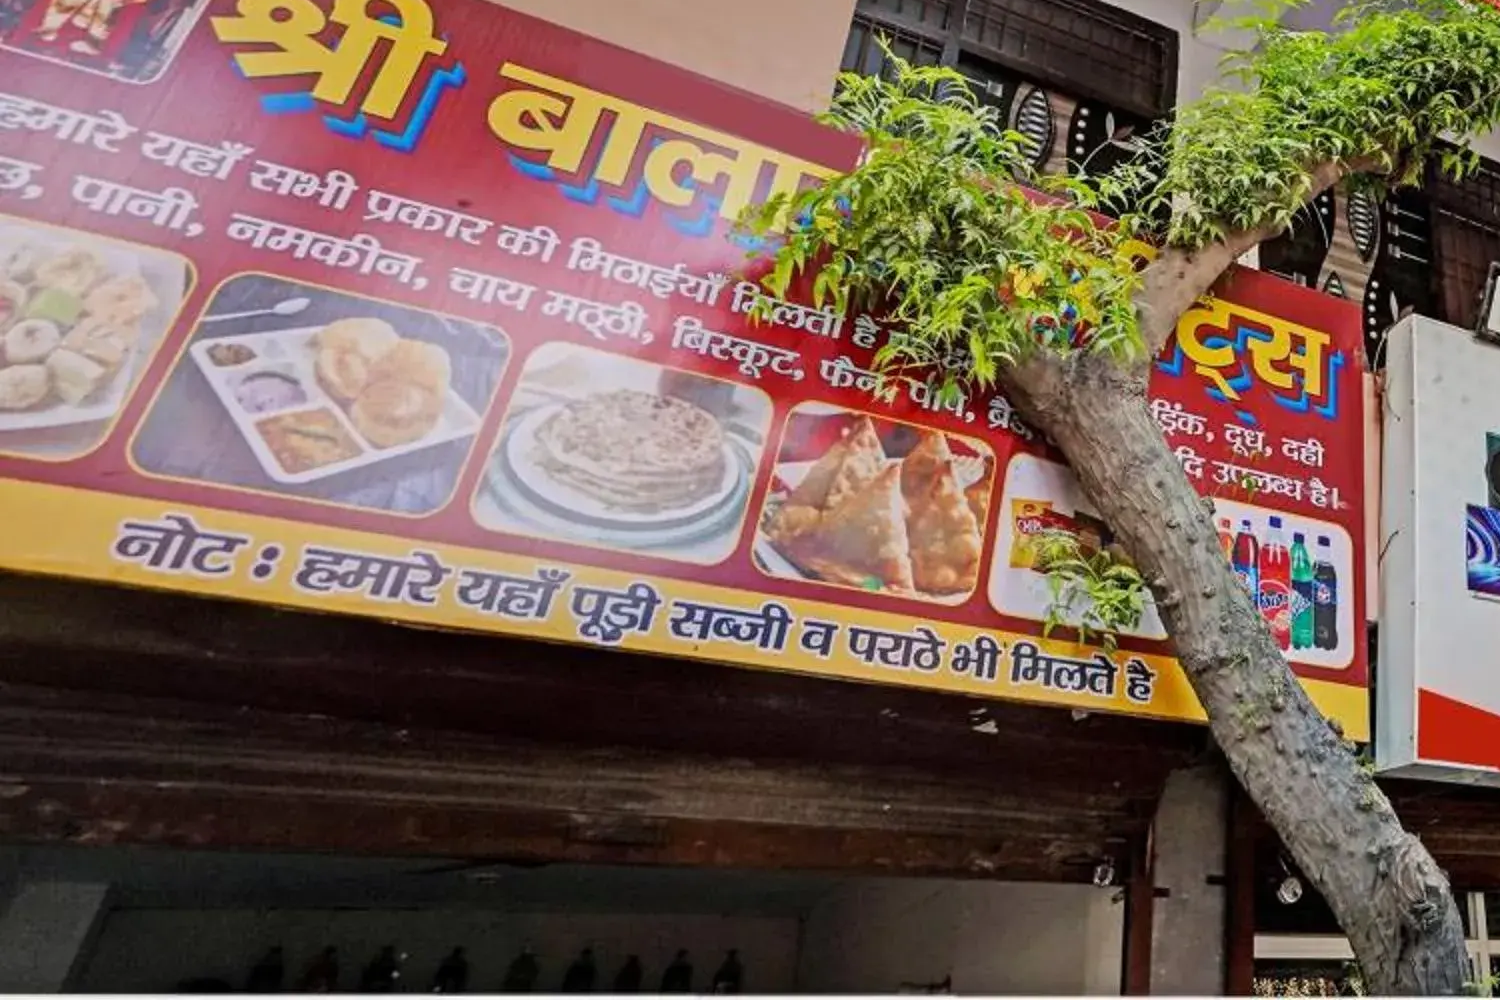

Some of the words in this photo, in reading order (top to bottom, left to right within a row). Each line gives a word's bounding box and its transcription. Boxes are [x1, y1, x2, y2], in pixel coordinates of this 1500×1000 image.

[0, 94, 138, 152] हमारे
[141, 132, 254, 180] यहाँ
[250, 160, 358, 210] सभी
[362, 190, 494, 245] प्रकार
[497, 224, 562, 264] की
[851, 317, 880, 348] है
[1281, 437, 1325, 467] दही
[72, 175, 206, 237] पानी,
[226, 212, 429, 291] नमकीन,
[448, 266, 540, 311] चाय
[296, 548, 453, 602] हमारे
[458, 569, 569, 619] यहाँ
[670, 601, 792, 652] सब्जी
[801, 619, 839, 658] व
[849, 620, 946, 675] पराठे
[952, 635, 1002, 681] भी
[1009, 642, 1118, 698] मिलते
[1126, 660, 1155, 702] है
